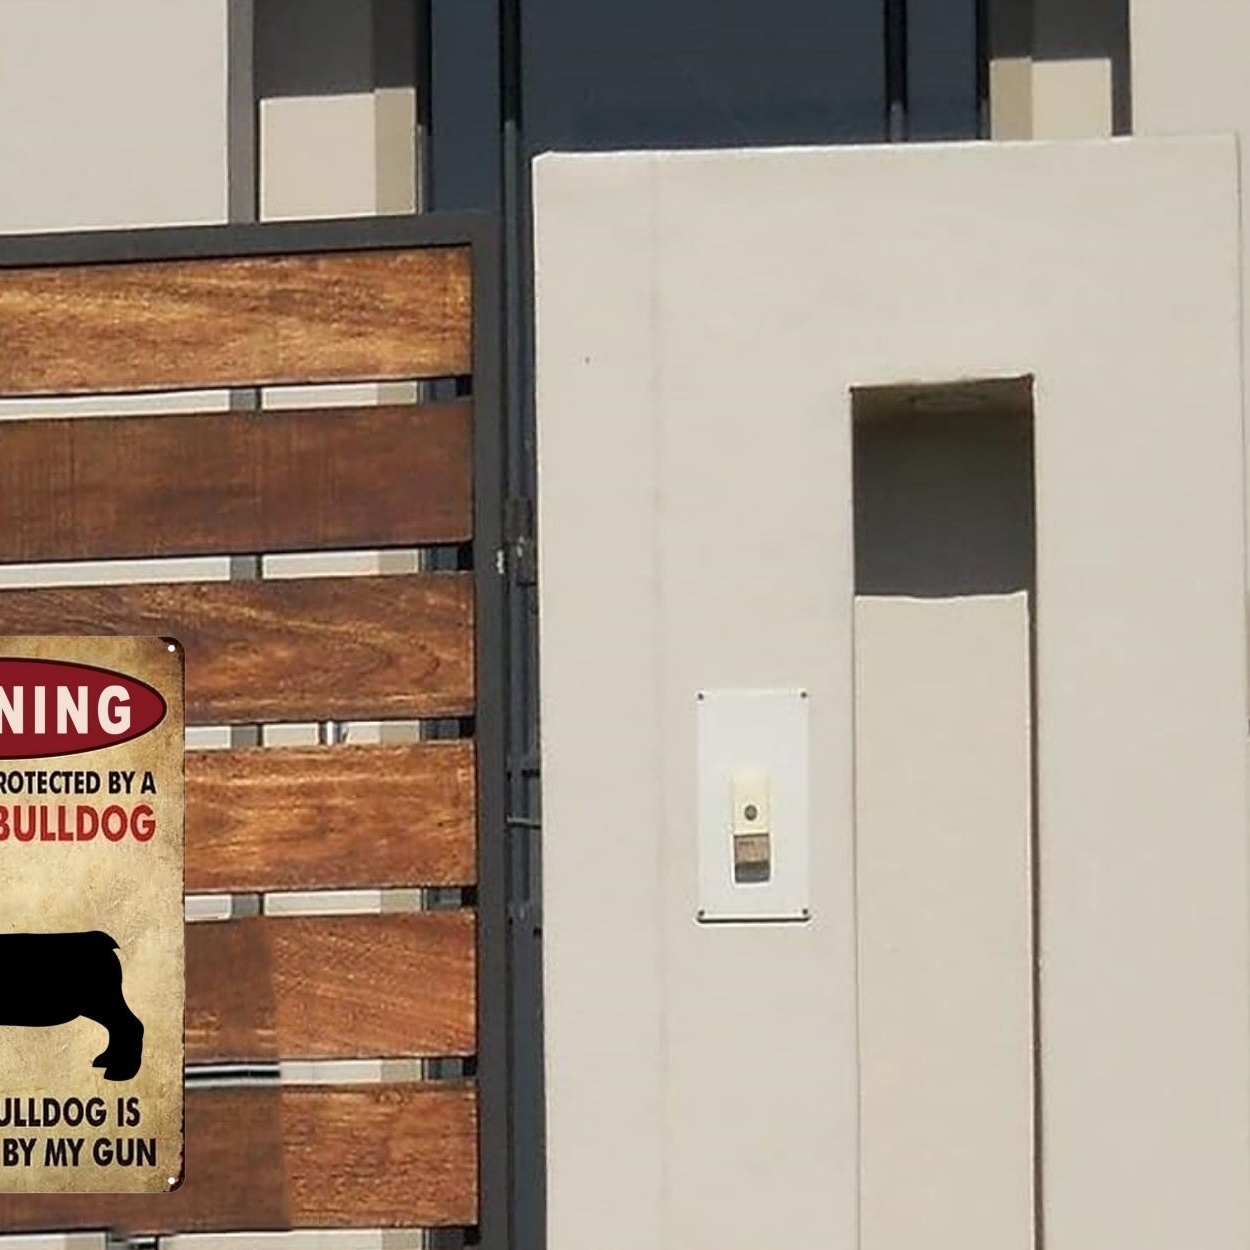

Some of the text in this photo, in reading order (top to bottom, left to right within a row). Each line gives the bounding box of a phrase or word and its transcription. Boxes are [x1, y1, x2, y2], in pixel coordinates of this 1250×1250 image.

[108, 771, 136, 794] BY
[140, 771, 157, 794] A
[117, 1097, 140, 1127] IS
[3, 1138, 36, 1167] BY
[44, 1138, 85, 1167] MY
[93, 1138, 157, 1167] GUN
